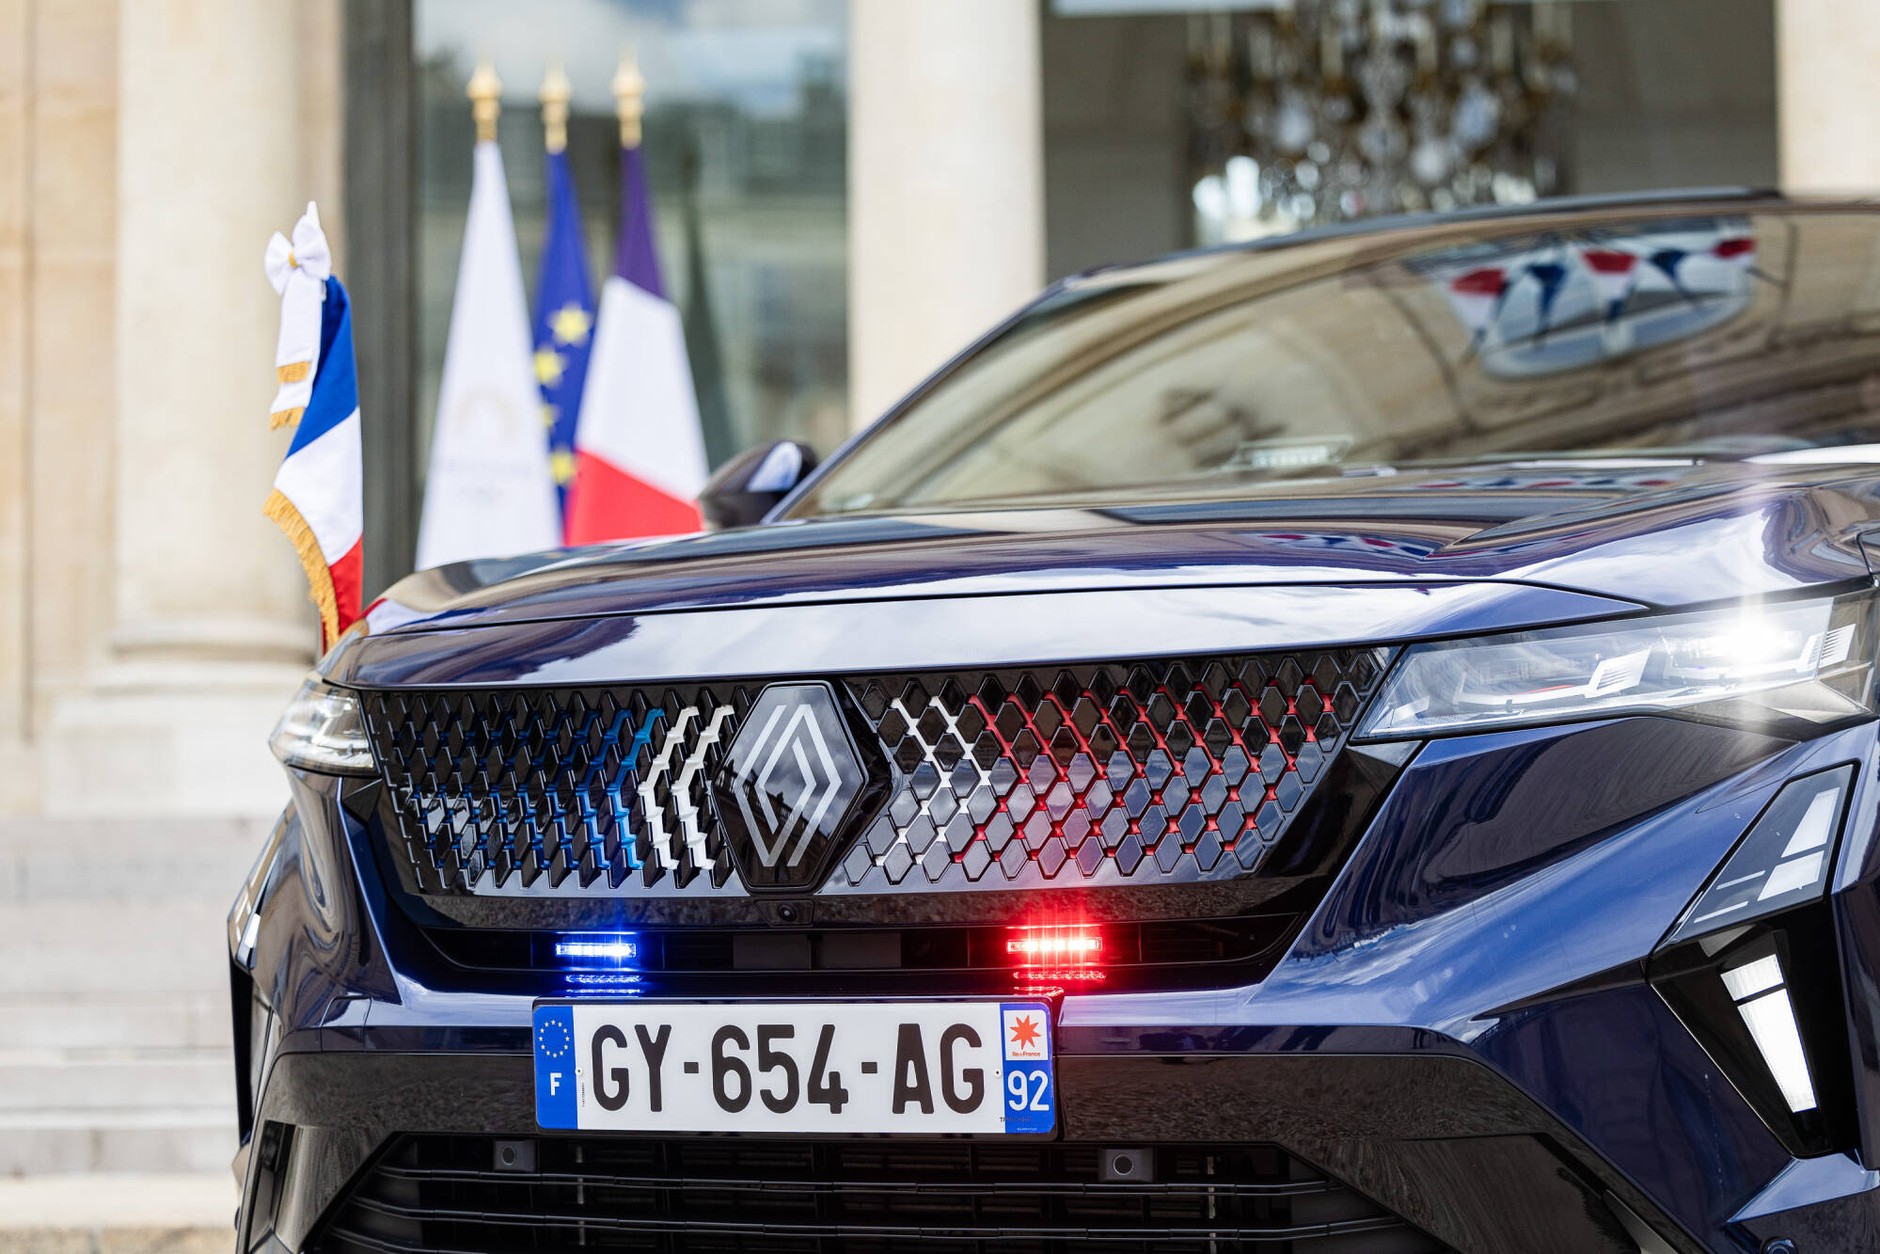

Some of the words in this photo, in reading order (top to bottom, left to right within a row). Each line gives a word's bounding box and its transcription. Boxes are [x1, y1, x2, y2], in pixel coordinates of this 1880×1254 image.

[550, 1072, 562, 1096] F
[591, 1023, 985, 1115] GY-654-AG
[1007, 1069, 1050, 1111] 92
